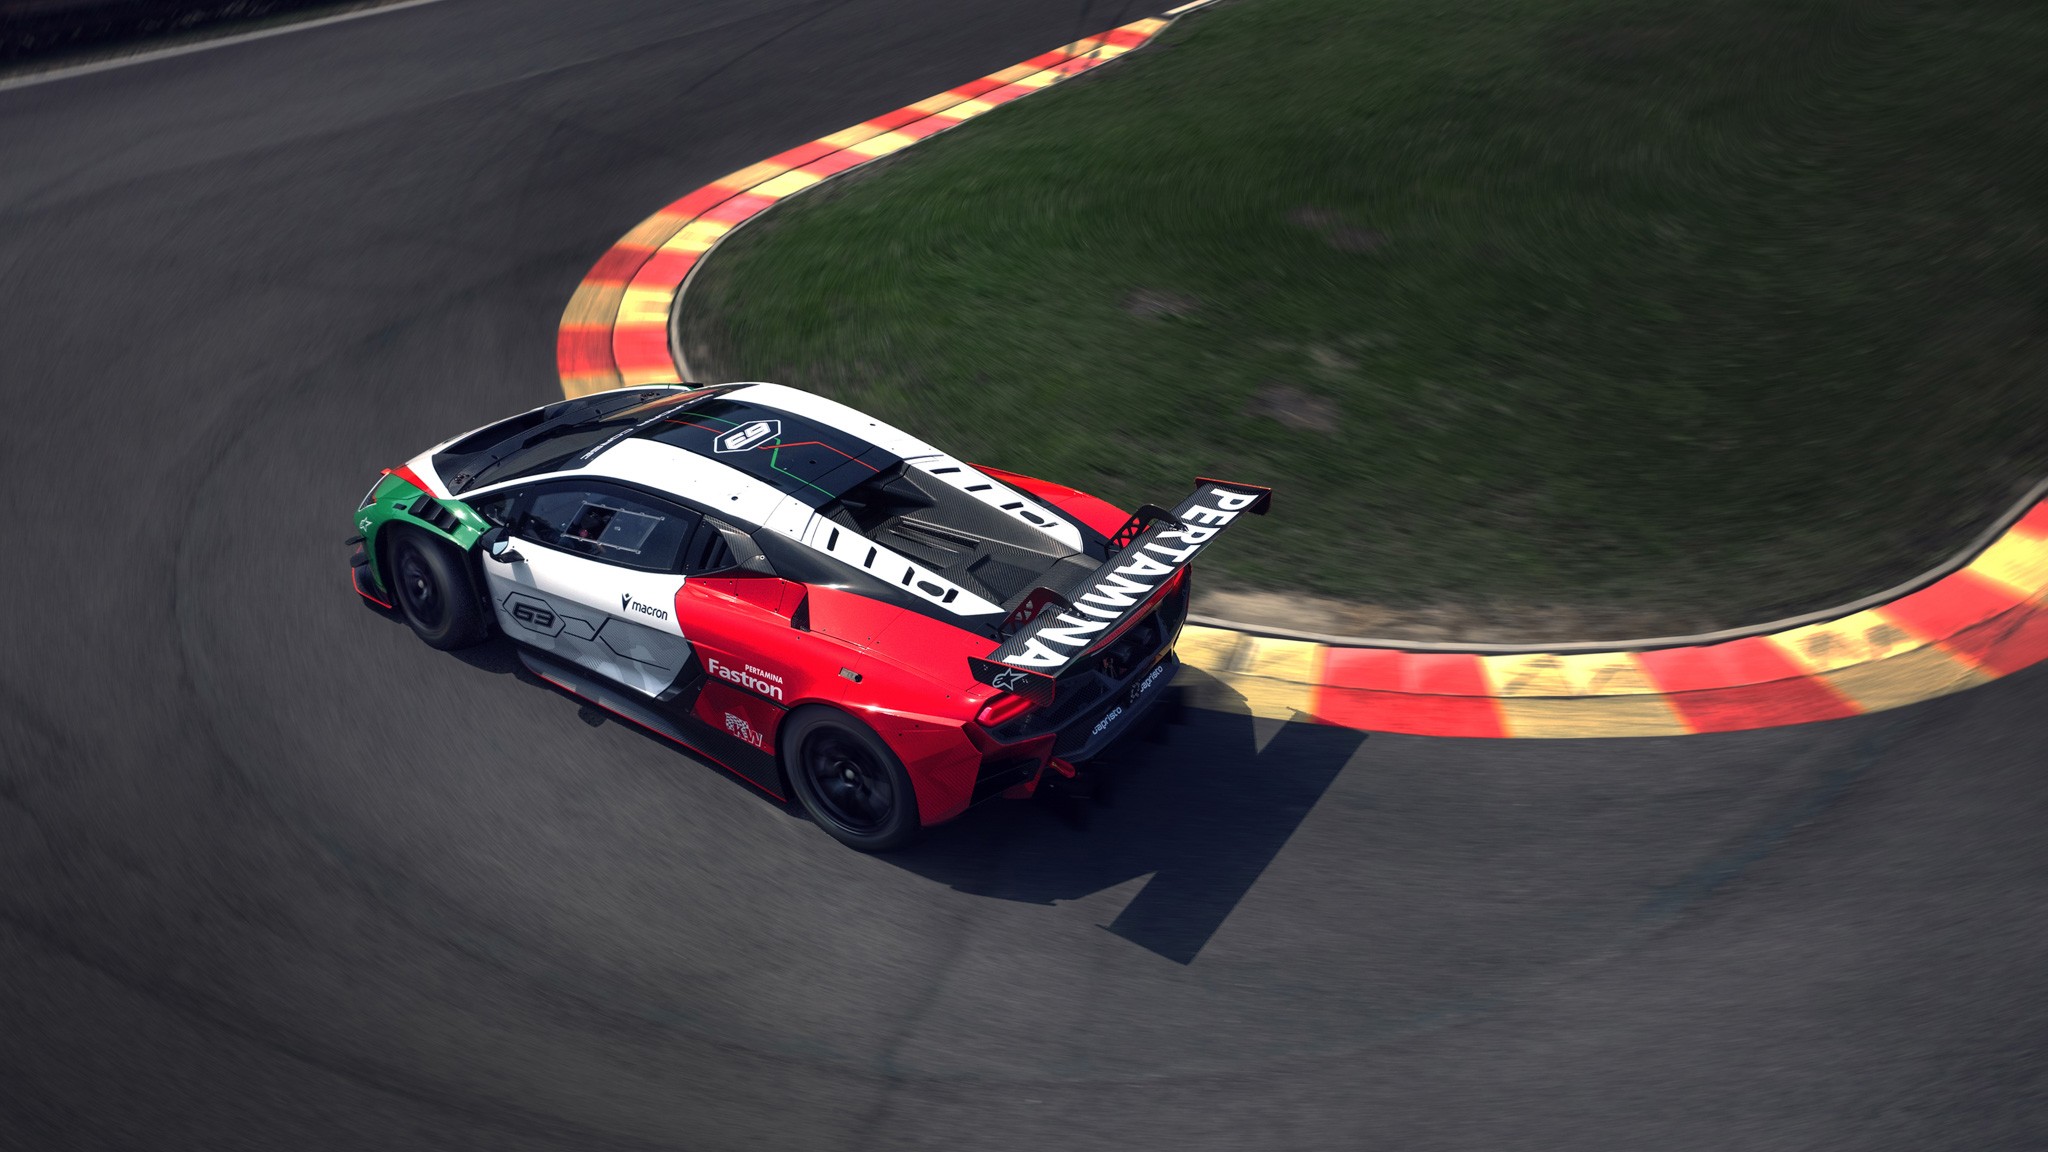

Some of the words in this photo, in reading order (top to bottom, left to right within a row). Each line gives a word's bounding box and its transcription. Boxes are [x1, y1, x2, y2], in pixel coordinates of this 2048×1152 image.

[724, 422, 771, 450] 63
[1002, 487, 1259, 668] PERTAMINA
[512, 601, 556, 629] 63
[631, 600, 668, 621] macron
[708, 658, 783, 701] Fastron
[745, 664, 783, 684] PERTAMINA
